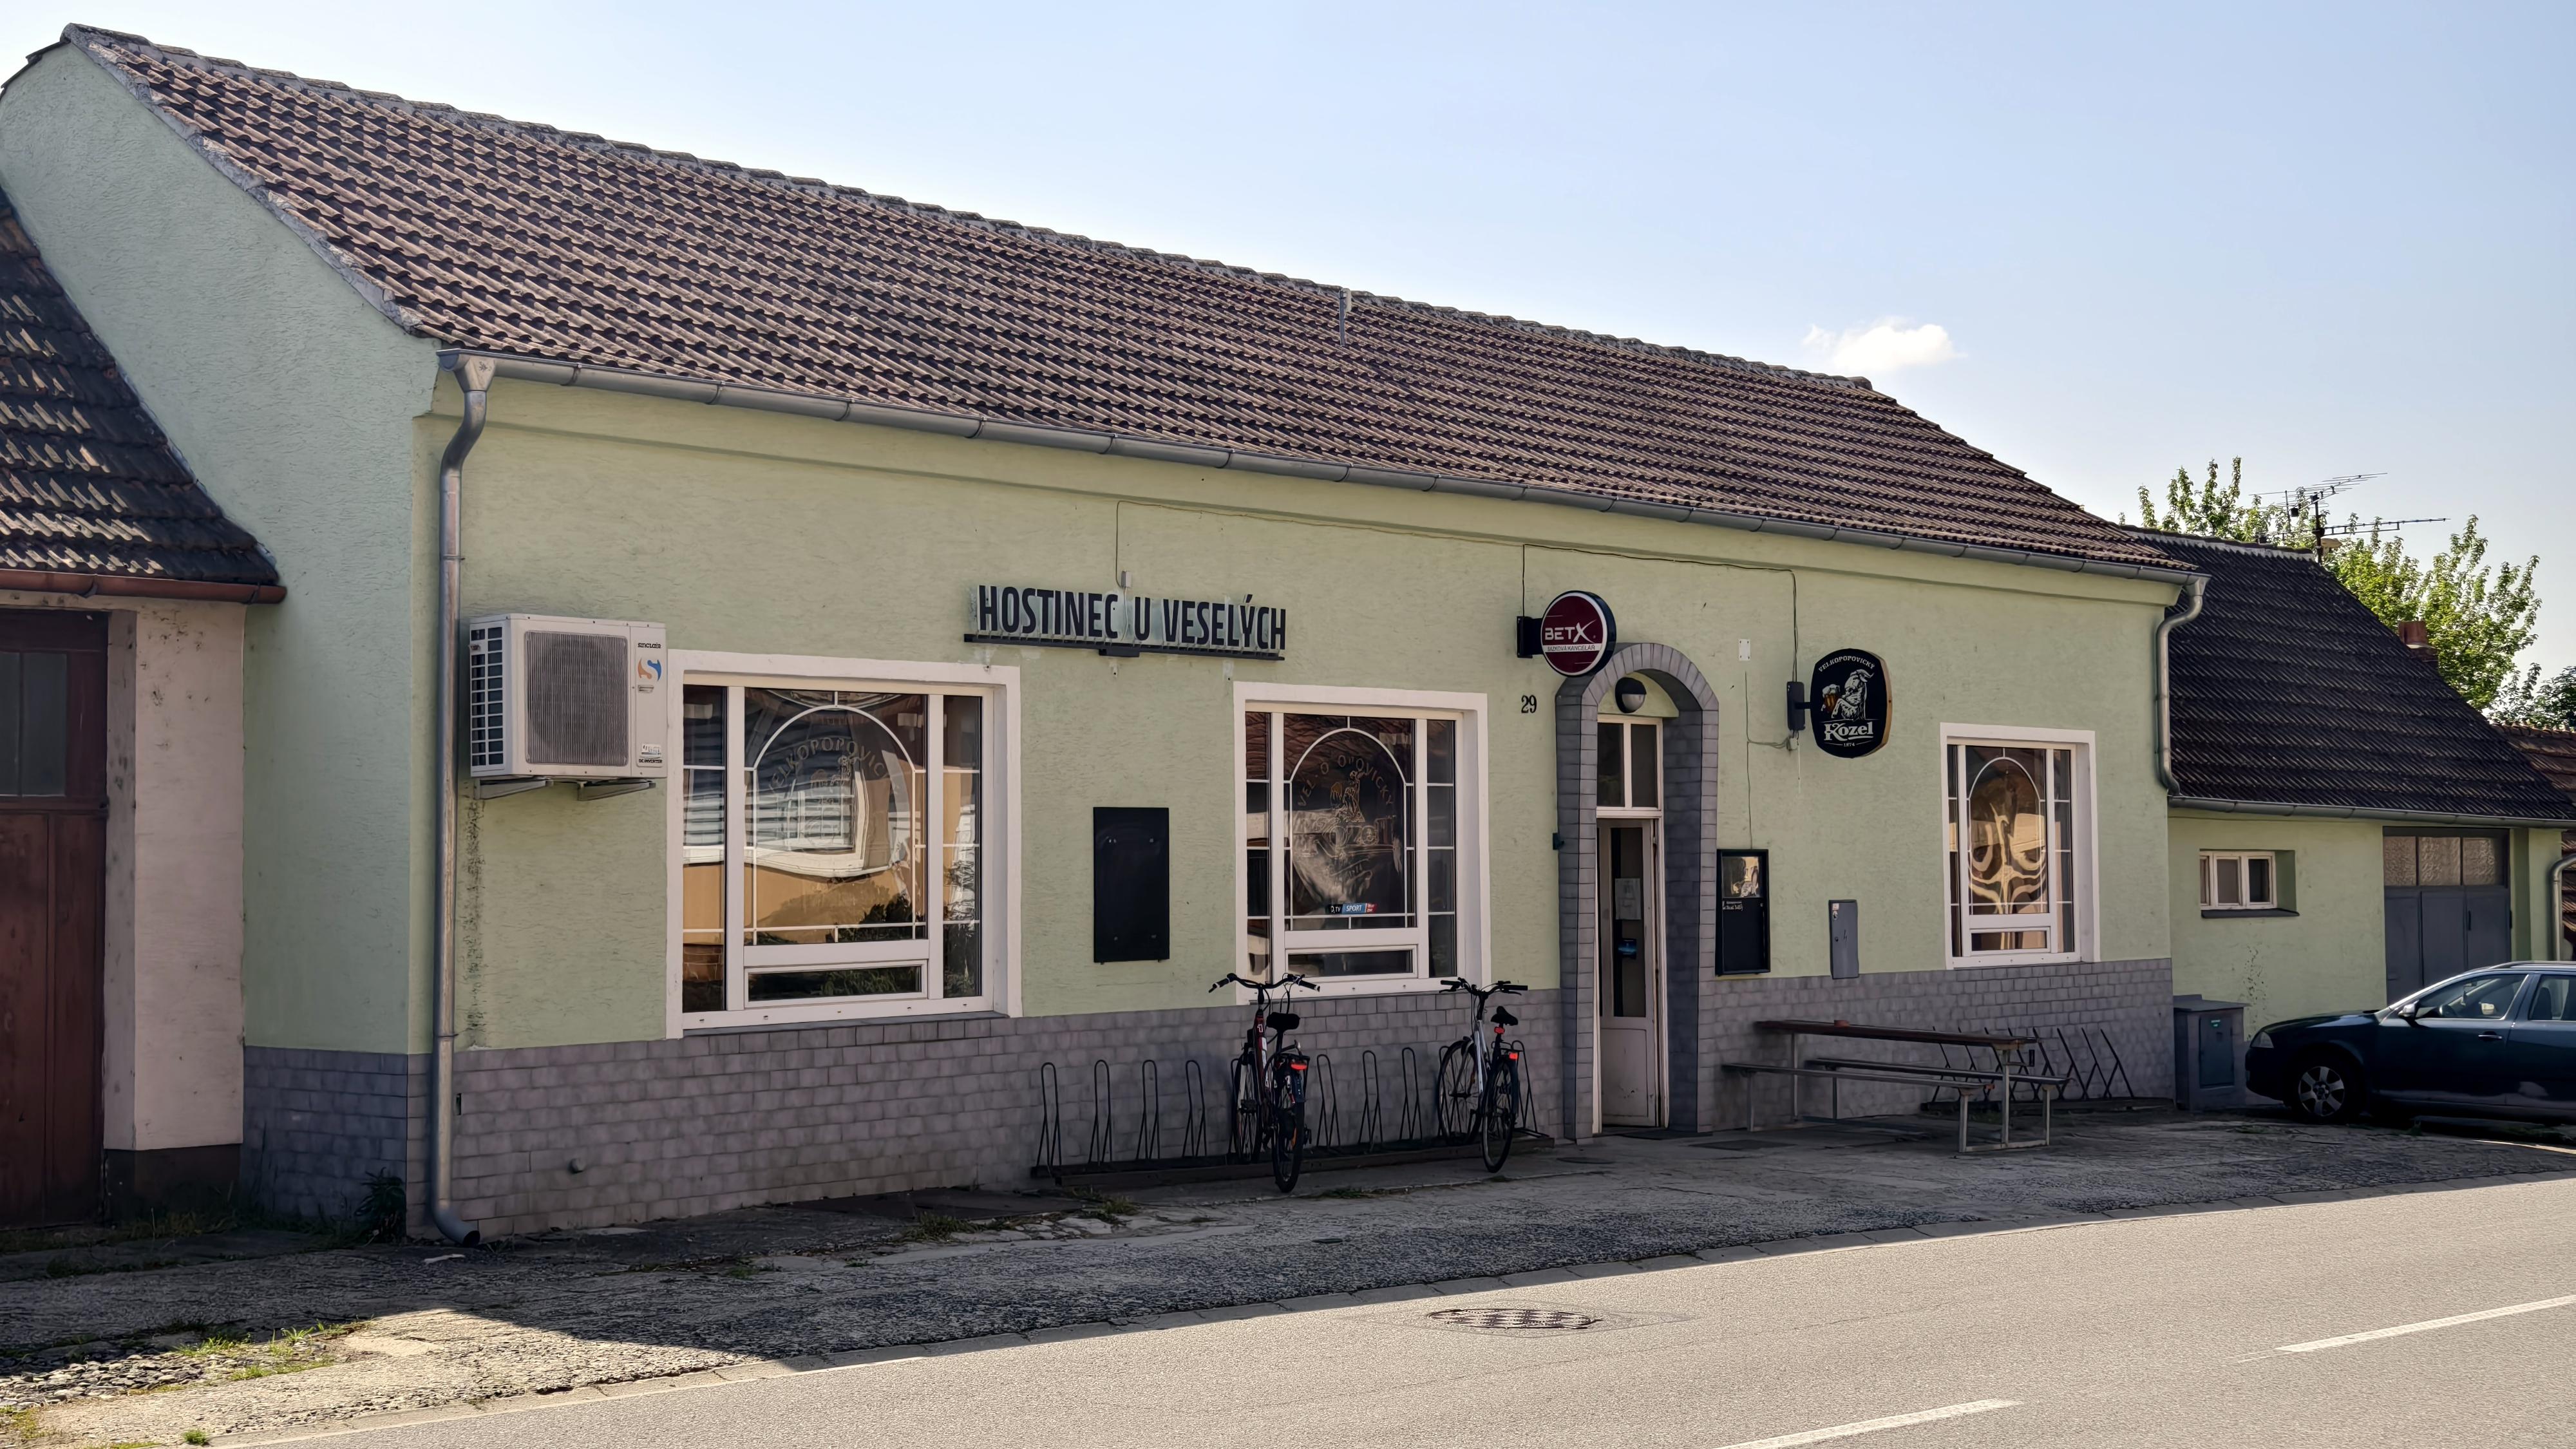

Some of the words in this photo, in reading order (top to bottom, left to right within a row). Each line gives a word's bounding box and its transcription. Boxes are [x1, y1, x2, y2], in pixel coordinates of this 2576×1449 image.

[979, 585, 1118, 639] HOSTINEC
[1135, 596, 1151, 641] U
[1162, 594, 1286, 650] VESELÝCH
[1545, 619, 1596, 644] BETX
[1521, 695, 1537, 714] 29
[1824, 721, 1873, 741] Kozel
